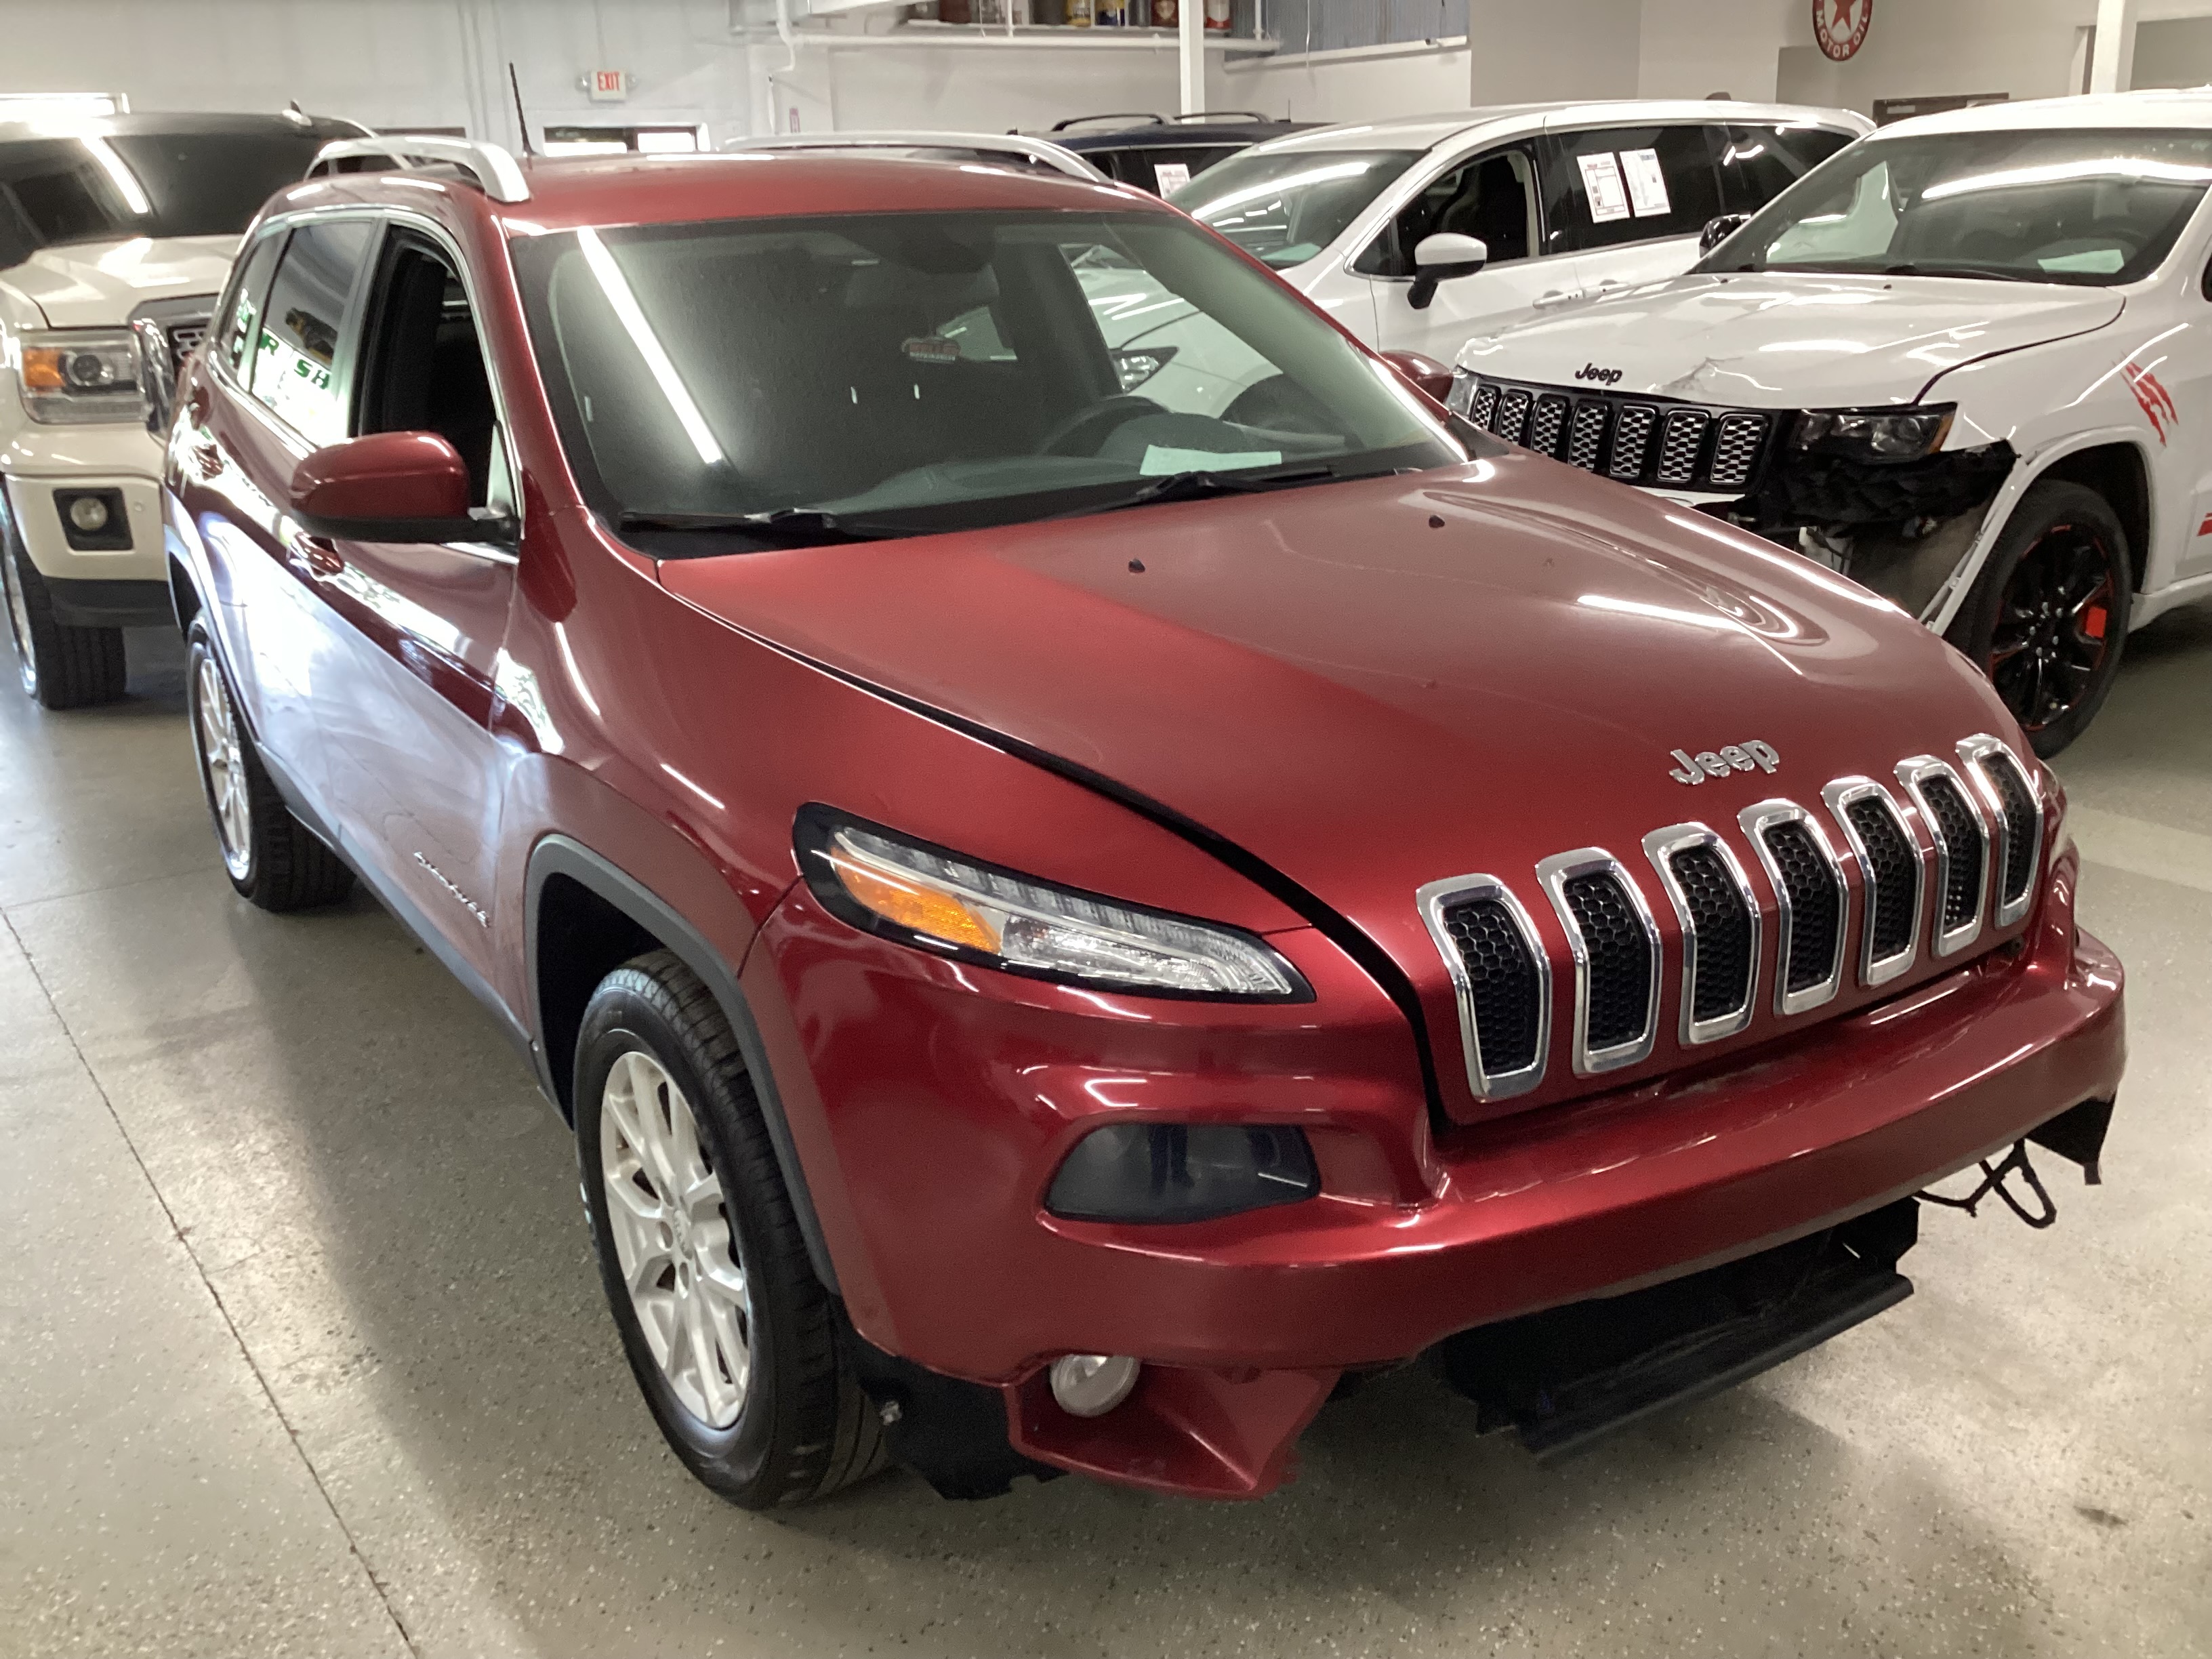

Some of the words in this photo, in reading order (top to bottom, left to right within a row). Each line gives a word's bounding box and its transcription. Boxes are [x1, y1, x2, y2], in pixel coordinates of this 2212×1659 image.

[1816, 9, 1849, 58] MOTOR
[1853, 15, 1868, 45] OIL
[596, 71, 620, 91] EXIT
[1574, 362, 1622, 386] Jeep
[1668, 740, 1780, 785] Jeep
